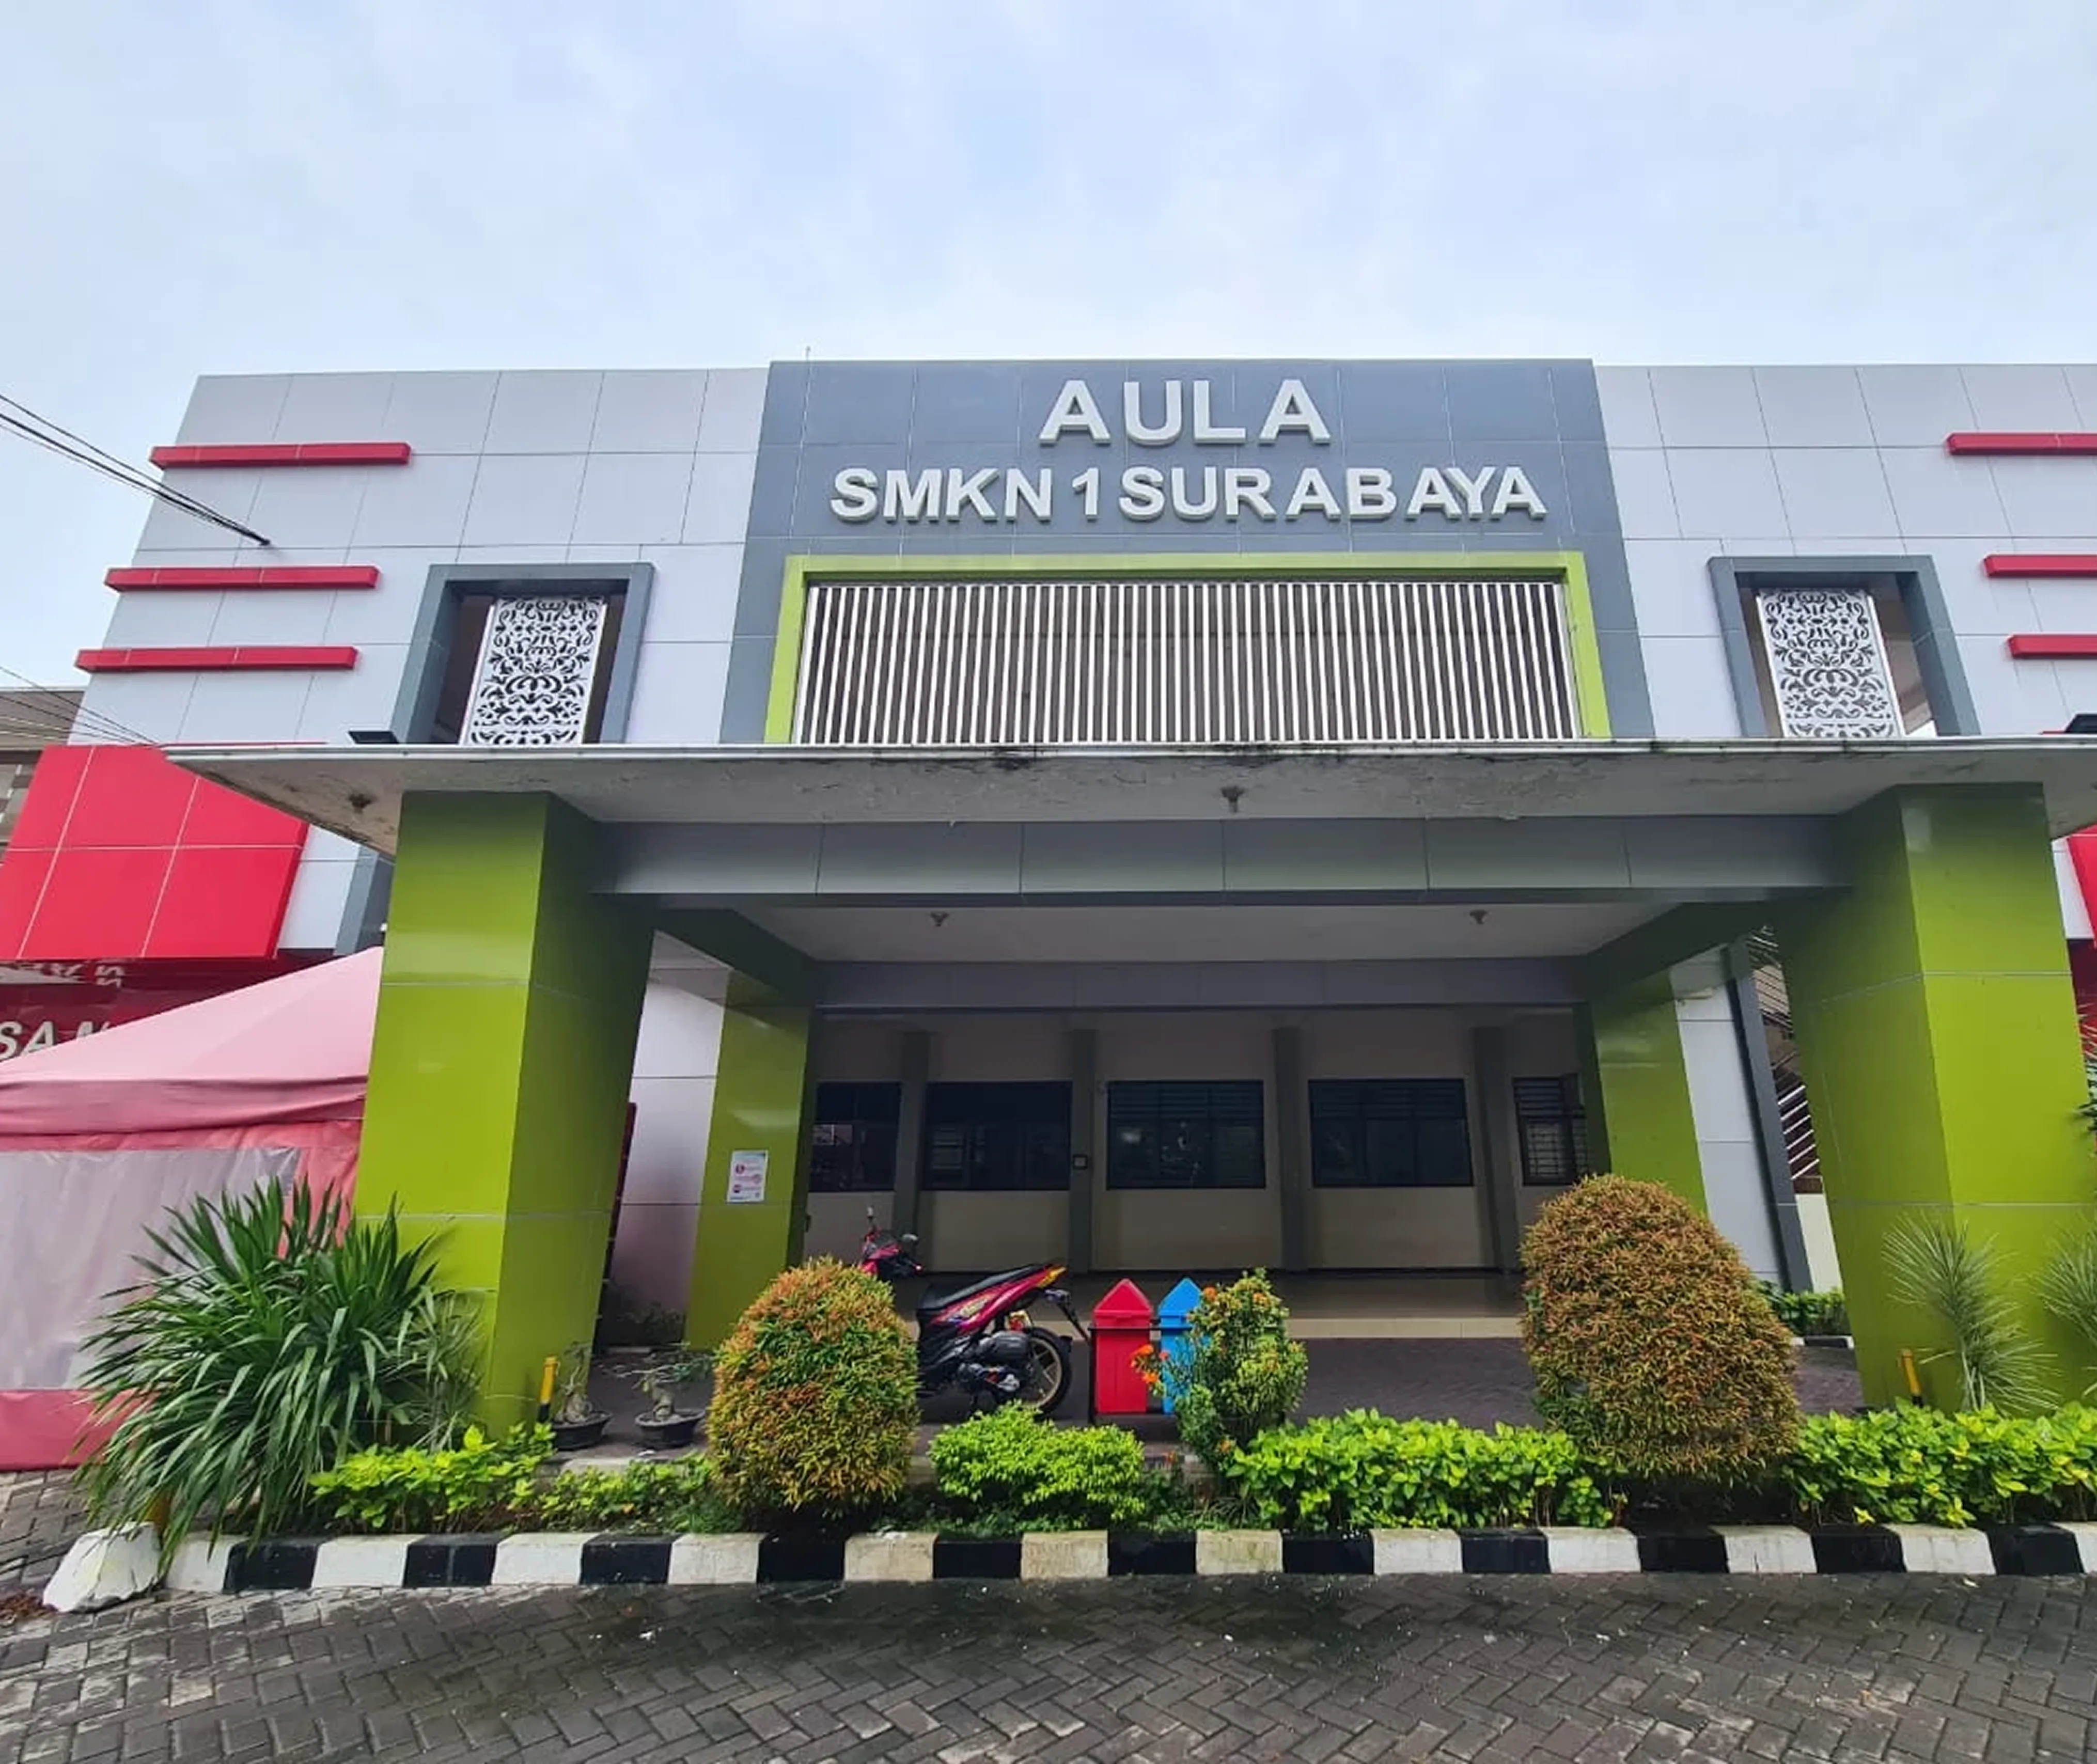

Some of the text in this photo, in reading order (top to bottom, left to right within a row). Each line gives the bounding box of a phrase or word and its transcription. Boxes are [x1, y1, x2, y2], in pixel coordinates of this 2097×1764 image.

[1038, 379, 1332, 445] AULA
[830, 466, 1548, 524] SMKN 1 SURABAYA
